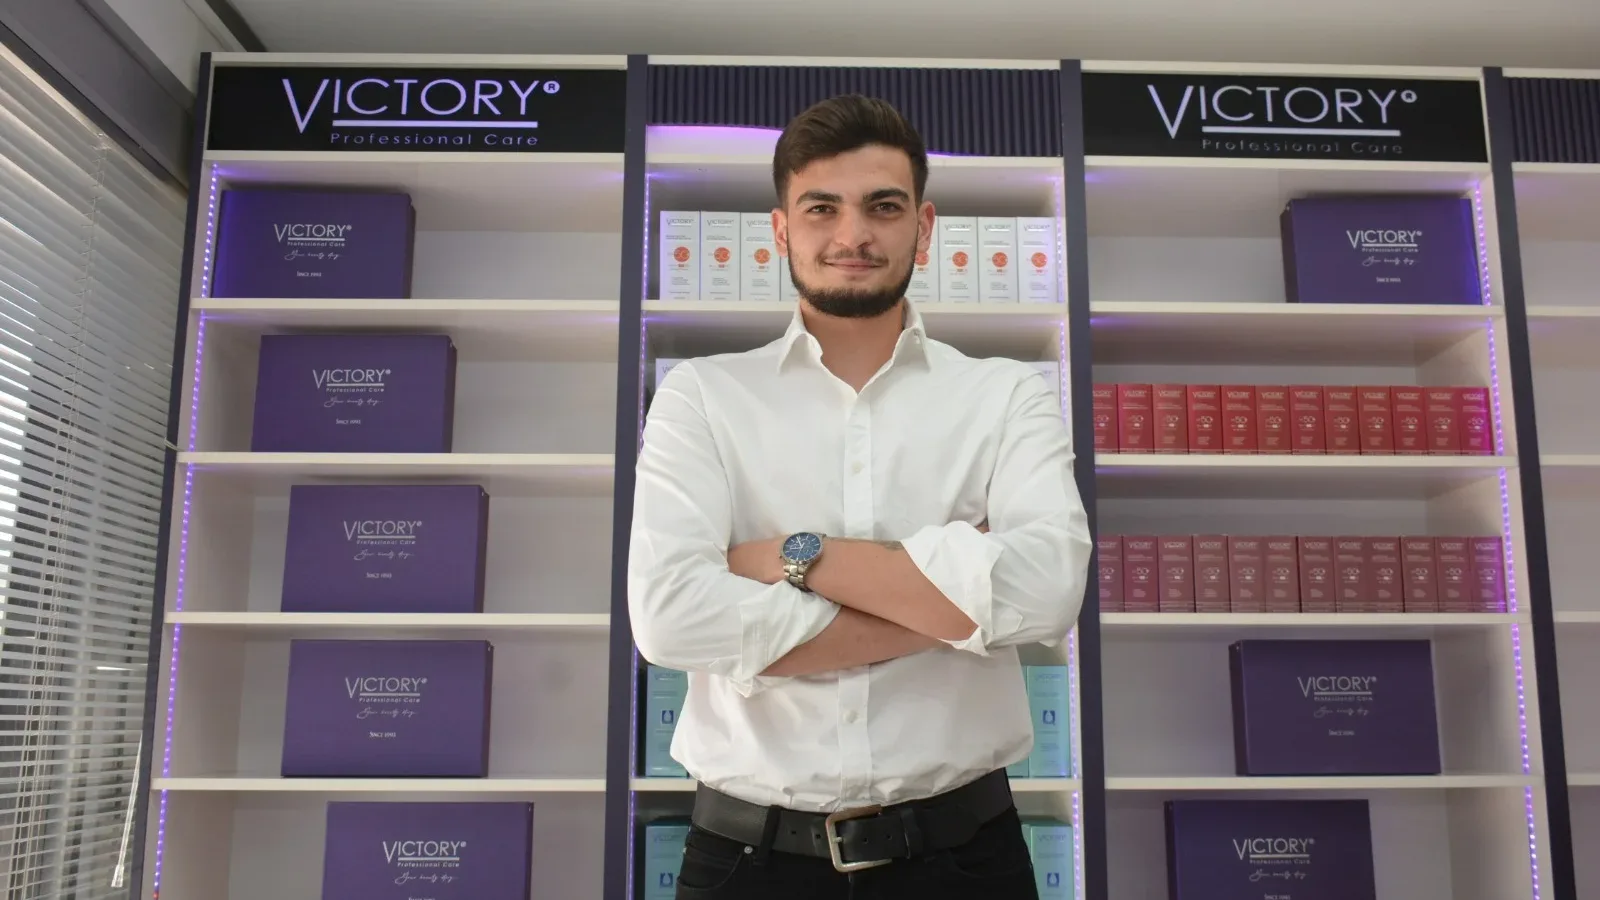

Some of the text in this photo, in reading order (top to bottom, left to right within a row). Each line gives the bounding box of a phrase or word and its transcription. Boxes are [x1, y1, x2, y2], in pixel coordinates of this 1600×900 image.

[330, 133, 538, 146] Professional Care
[1202, 139, 1403, 154] Professional Care
